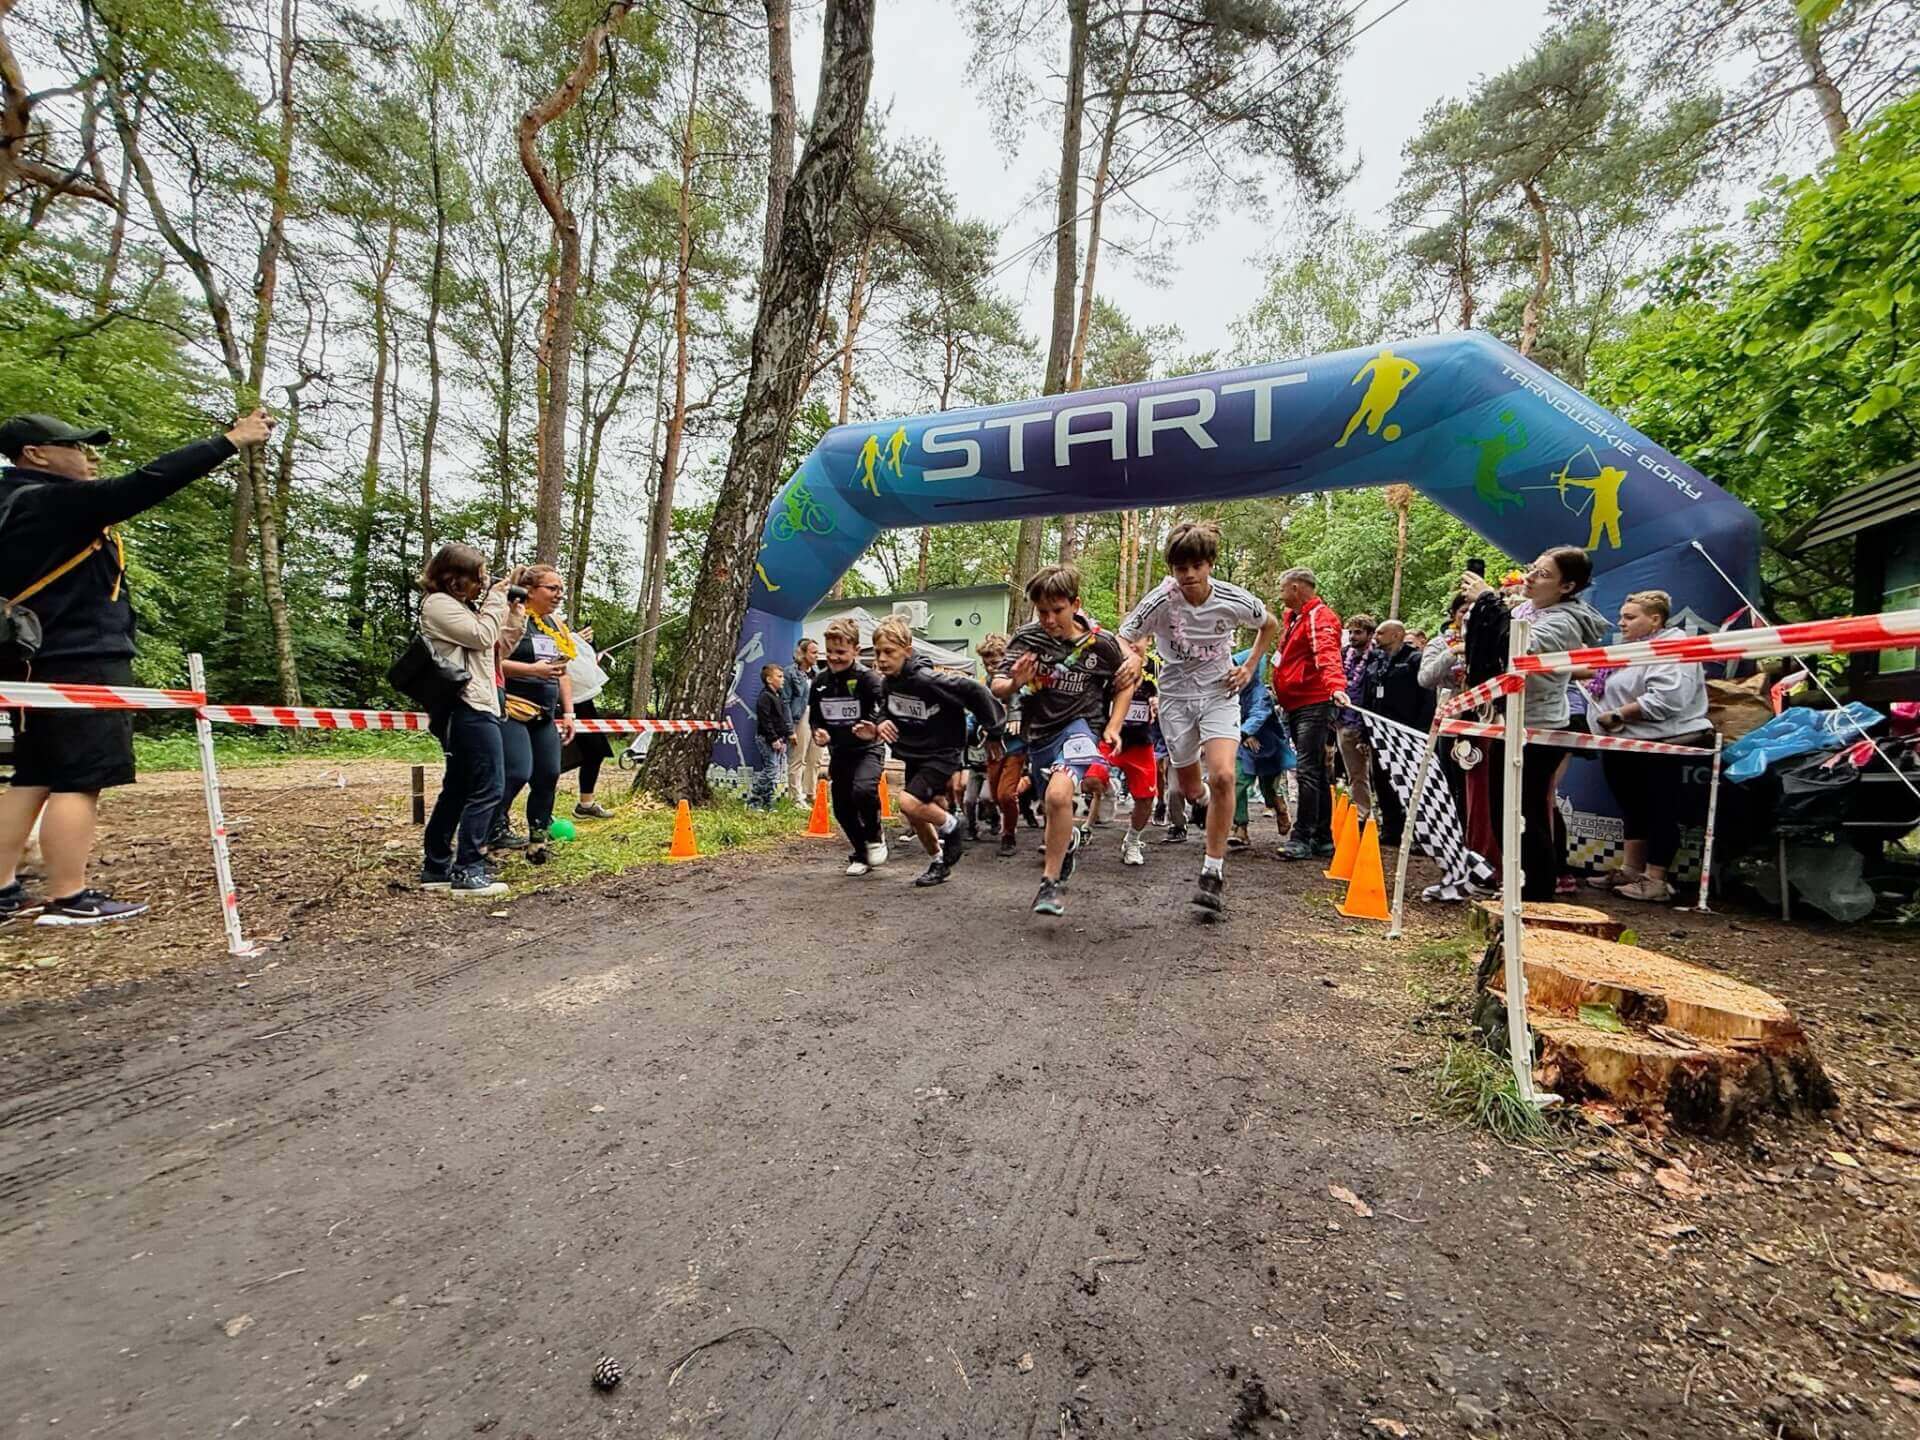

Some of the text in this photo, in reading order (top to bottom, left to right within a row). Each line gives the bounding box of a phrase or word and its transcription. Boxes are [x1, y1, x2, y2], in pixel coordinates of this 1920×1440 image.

[921, 372, 1309, 483] START
[1502, 364, 1703, 500] TARNOWSKIE GÓRY
[1131, 709, 1147, 720] 247
